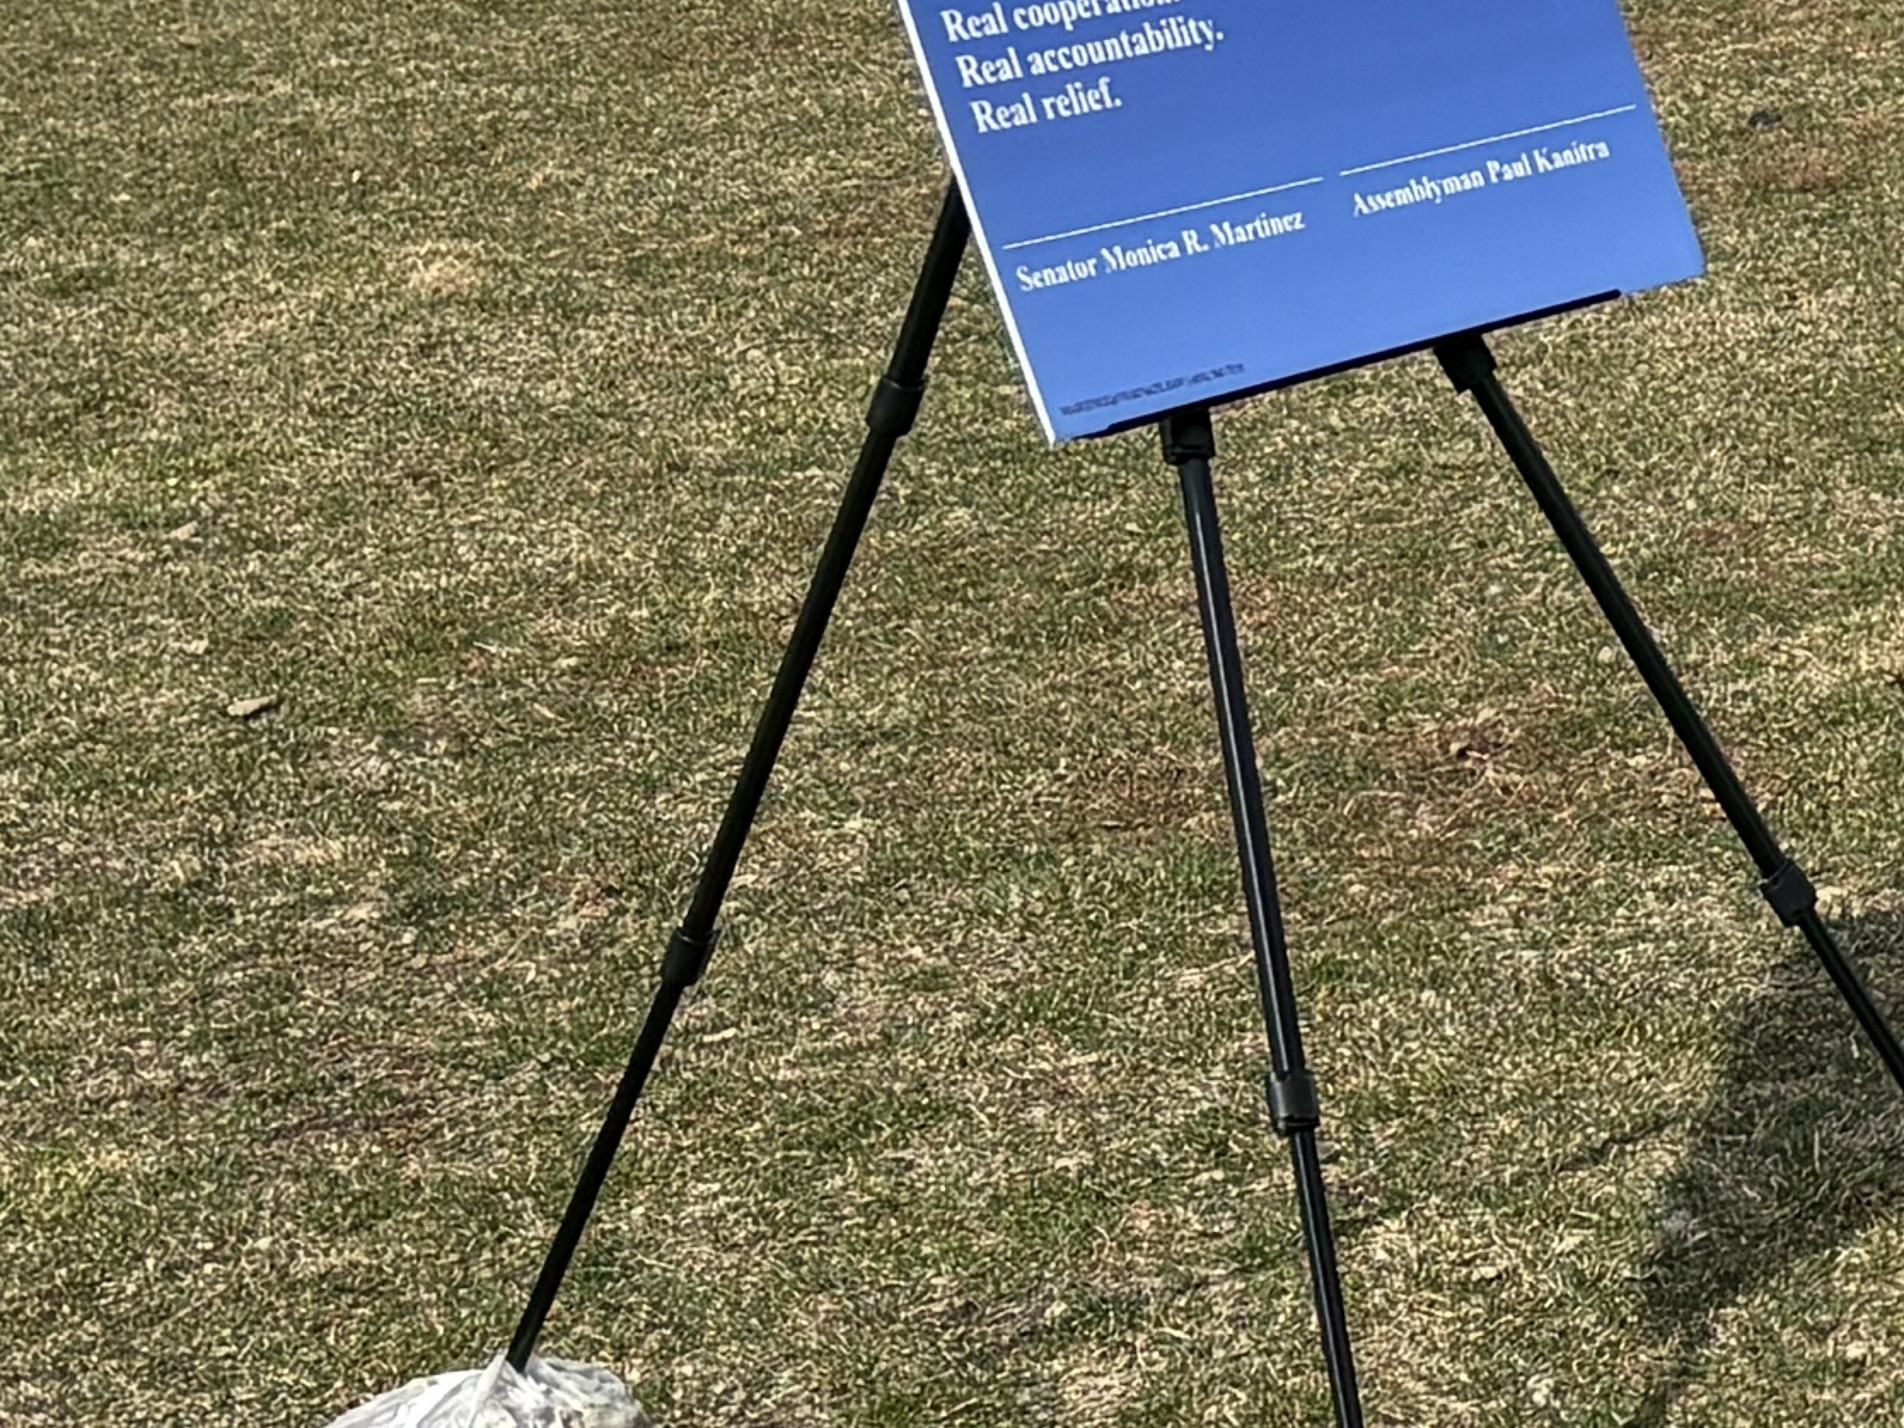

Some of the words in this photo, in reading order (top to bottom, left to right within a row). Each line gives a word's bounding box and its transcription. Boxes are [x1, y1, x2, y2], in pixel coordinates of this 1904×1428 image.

[941, 2, 1008, 42] Real
[955, 47, 1023, 88] Real
[1027, 16, 1224, 75] accountability.
[970, 92, 1038, 133] Real
[1042, 77, 1122, 120] relief.
[1354, 171, 1485, 216] Assemblyman
[1486, 153, 1532, 183] Paul
[1533, 141, 1609, 173] Kanitra
[1016, 258, 1097, 291] Senator
[1101, 239, 1181, 273] Monica
[1182, 230, 1209, 255] R.
[1210, 212, 1305, 247] Martinez
